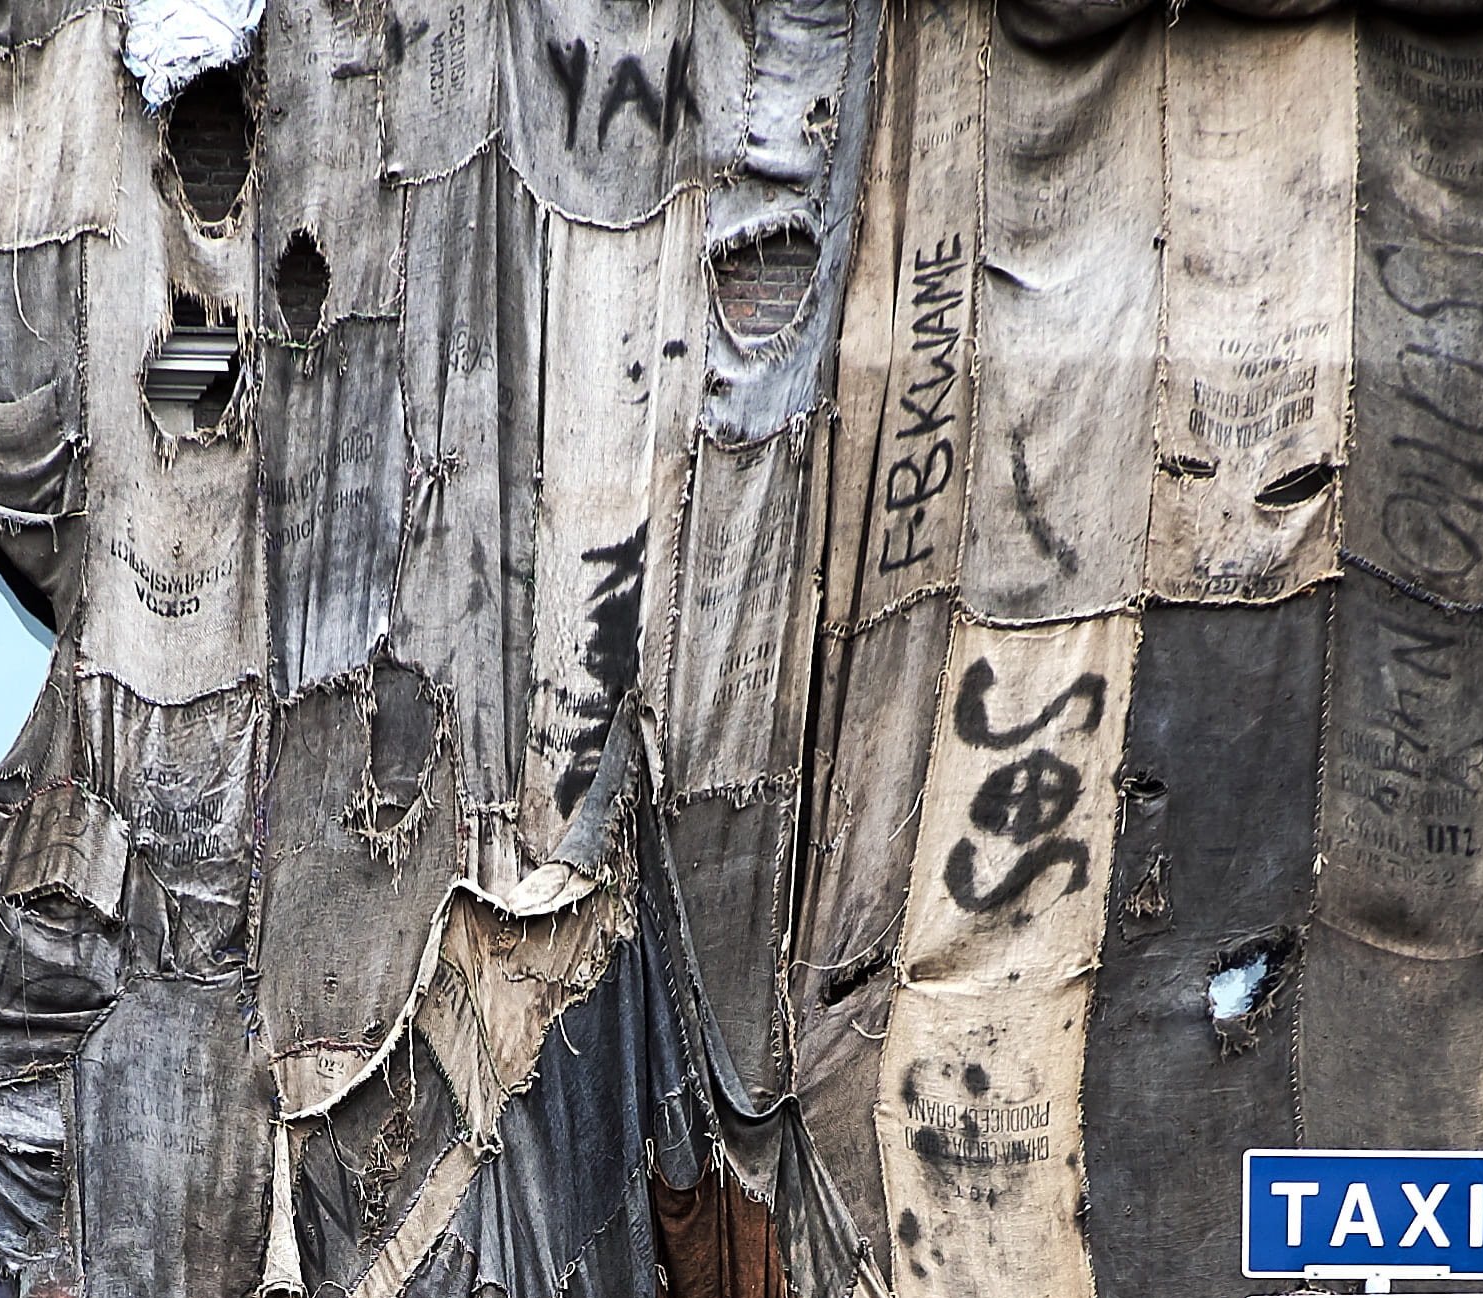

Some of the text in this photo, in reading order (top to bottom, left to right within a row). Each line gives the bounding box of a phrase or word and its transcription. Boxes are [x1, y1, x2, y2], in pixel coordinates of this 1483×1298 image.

[906, 1098, 957, 1129] GHANA
[979, 1100, 1051, 1134] PRODUCE
[1001, 1135, 1050, 1166] GHANA
[1271, 1182, 1483, 1249] TAXI
